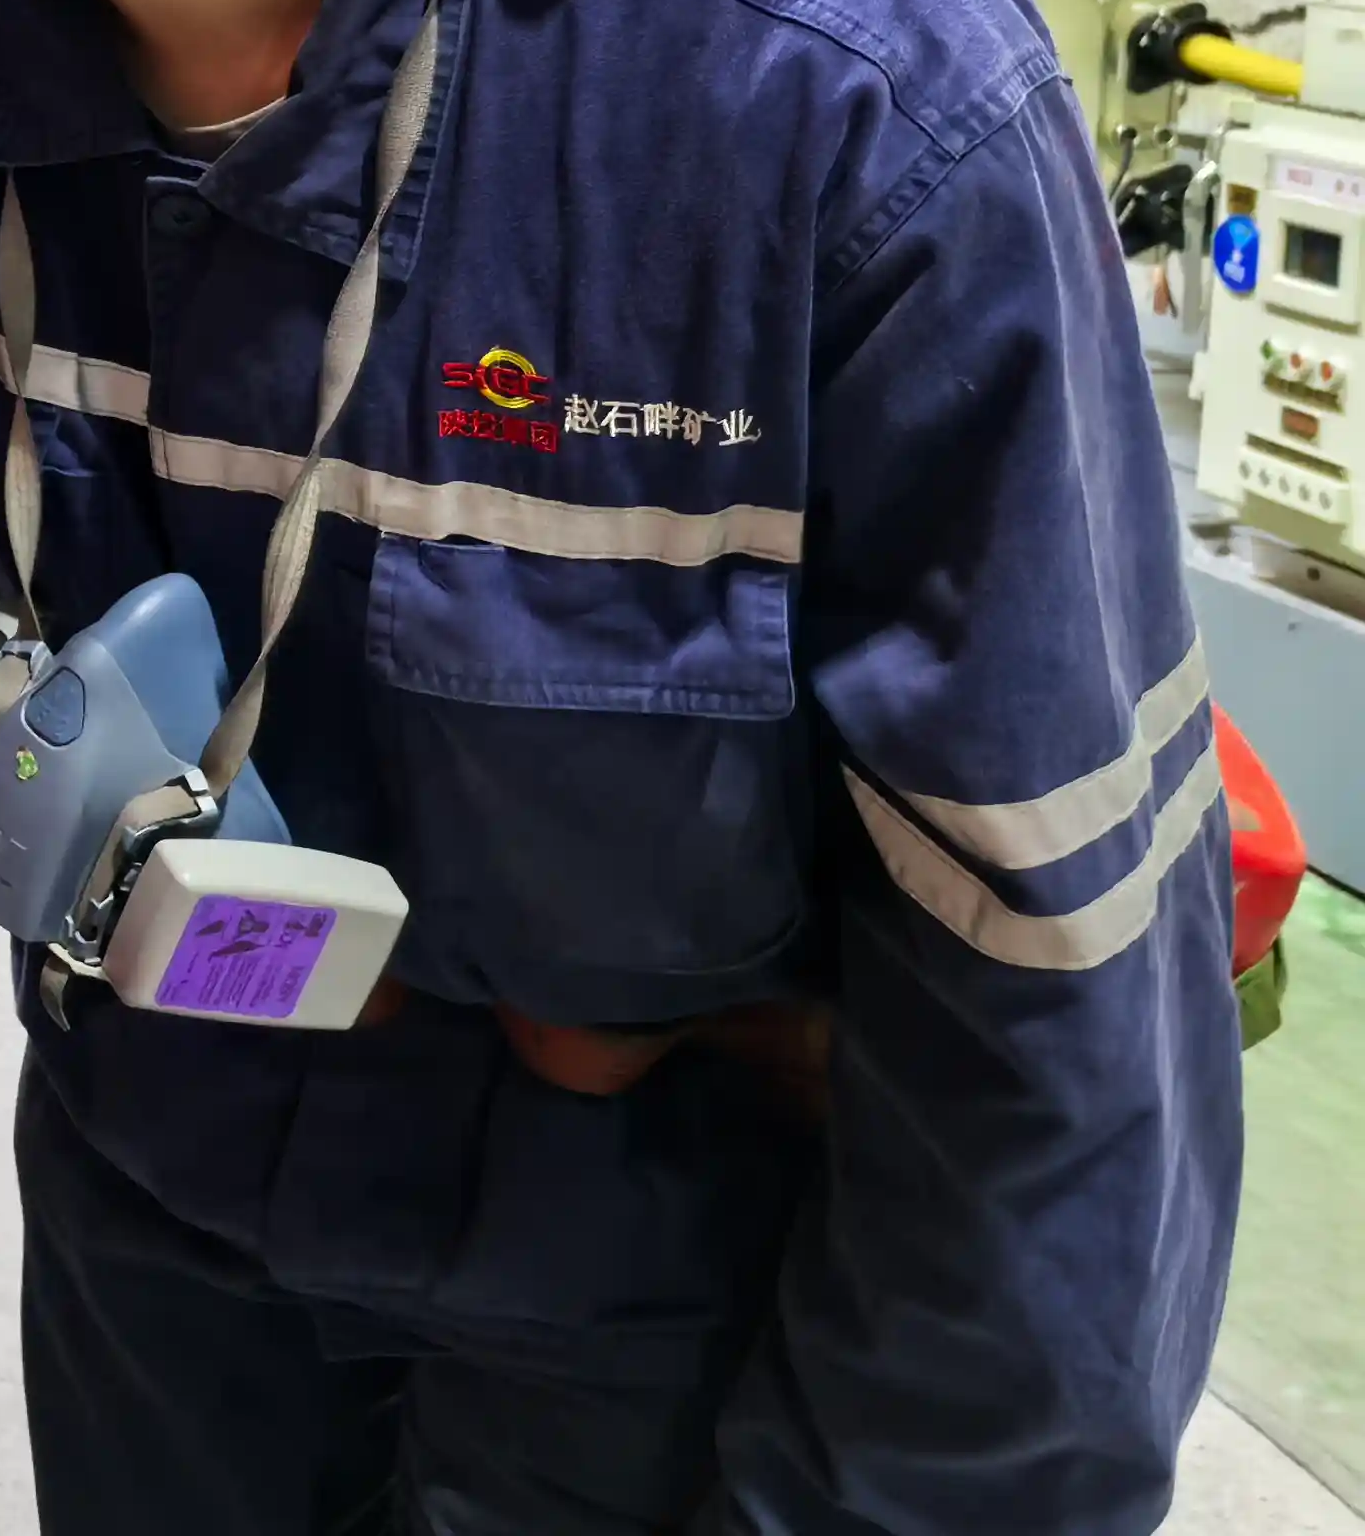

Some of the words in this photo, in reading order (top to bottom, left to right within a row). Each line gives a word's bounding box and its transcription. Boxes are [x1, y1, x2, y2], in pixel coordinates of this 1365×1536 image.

[564, 393, 762, 448] 赵石畔矿业
